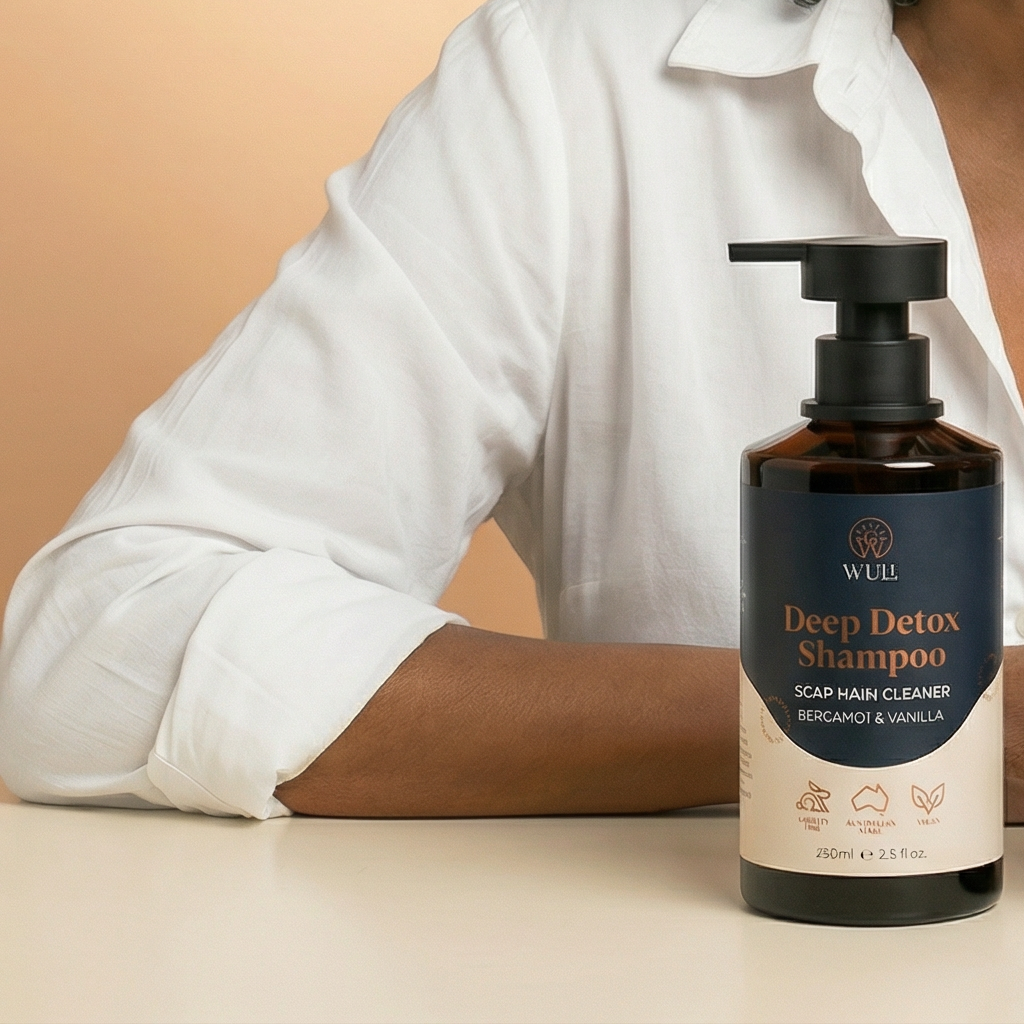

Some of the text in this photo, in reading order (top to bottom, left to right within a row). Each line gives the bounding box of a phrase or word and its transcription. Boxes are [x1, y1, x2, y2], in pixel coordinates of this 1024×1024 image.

[784, 604, 960, 643] Deep Detox
[798, 640, 947, 677] Shampoo
[794, 684, 834, 700] SCAP
[882, 684, 951, 701] CLEANER
[874, 711, 885, 724] &
[887, 709, 945, 724] VANILLA
